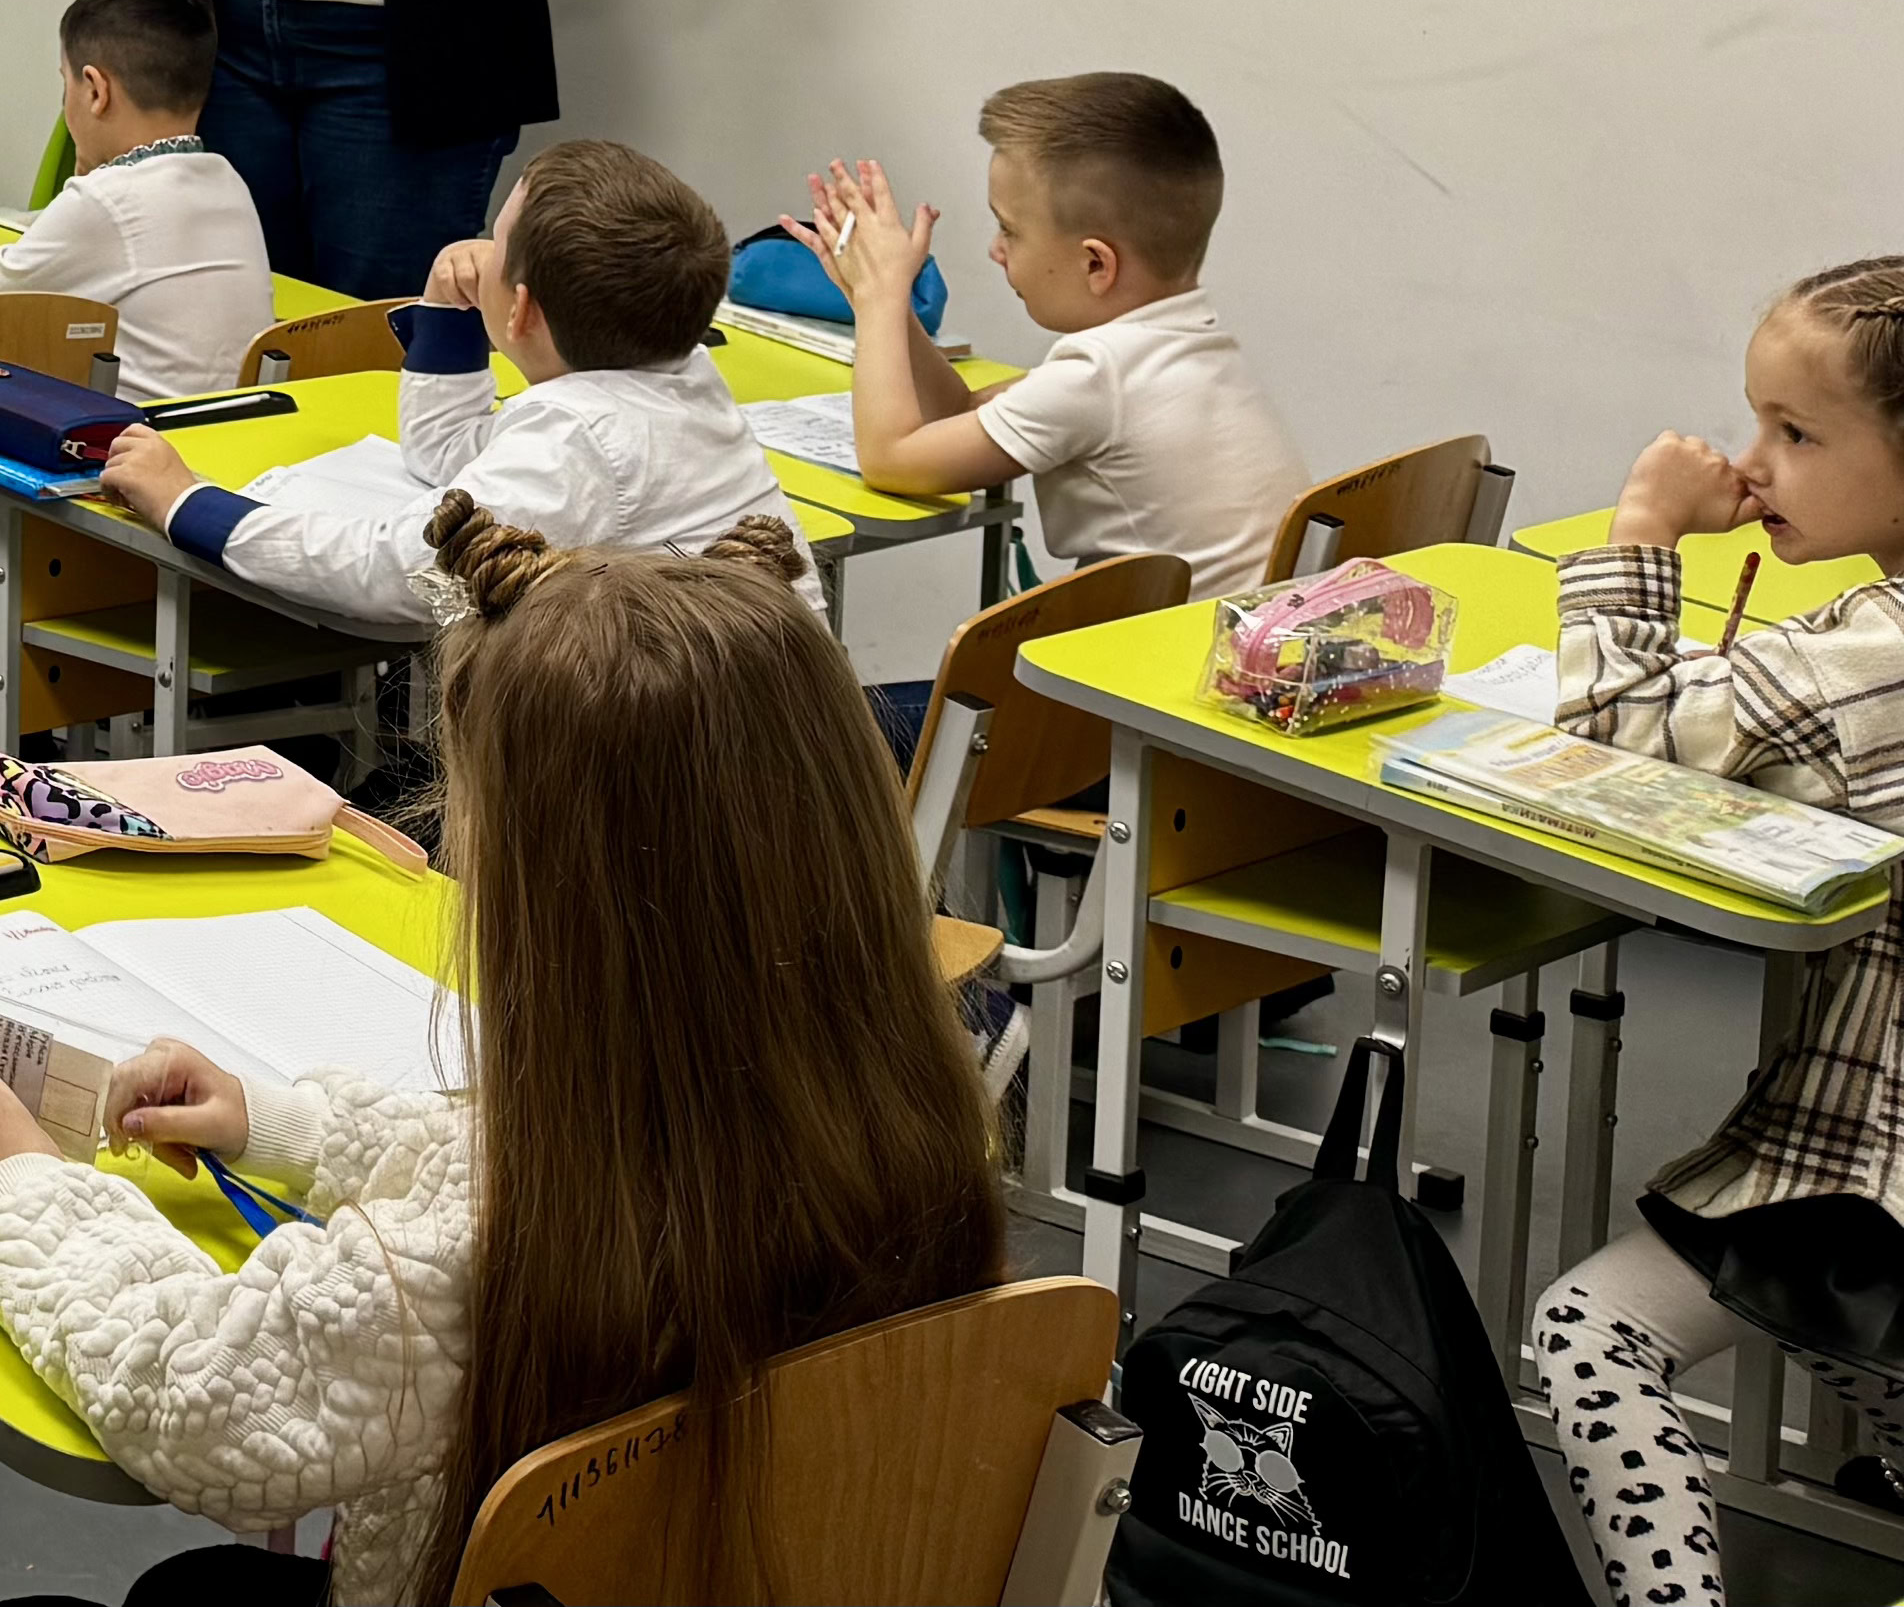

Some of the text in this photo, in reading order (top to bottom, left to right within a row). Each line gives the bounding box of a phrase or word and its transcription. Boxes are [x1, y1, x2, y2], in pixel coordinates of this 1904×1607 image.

[1178, 1357, 1314, 1424] LIGHT SIDE
[1178, 1491, 1352, 1580] DANCE SCHOOL
